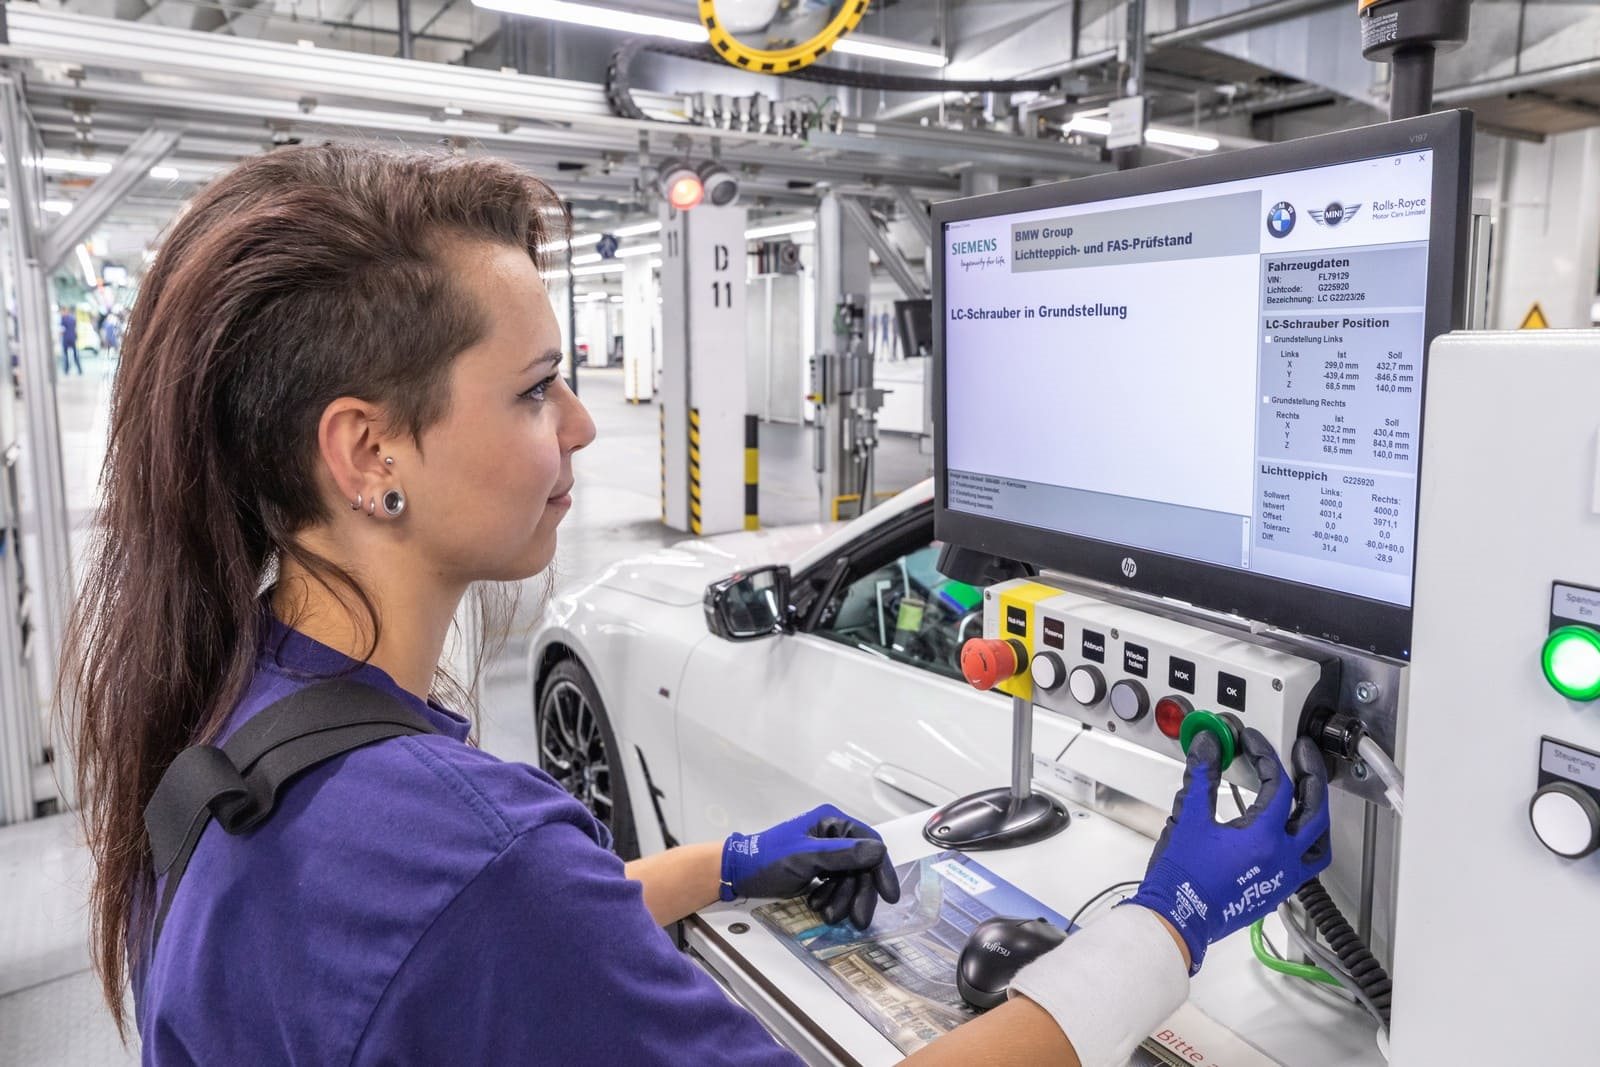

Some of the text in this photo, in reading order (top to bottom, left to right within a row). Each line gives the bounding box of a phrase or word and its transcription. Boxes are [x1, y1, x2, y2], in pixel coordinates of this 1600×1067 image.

[1372, 198, 1426, 210] Rolls-Royce
[1325, 210, 1342, 218] MINI
[1015, 226, 1073, 242] BMW Group
[952, 238, 997, 256] SIEMENS
[1015, 232, 1193, 261] Lichtteppich- und FAS-Prüfstand
[714, 244, 729, 272] D
[1268, 258, 1350, 272] Fahrzeugdaten
[1318, 272, 1349, 281] FL79129
[1267, 283, 1349, 294] Lichtcode: G225920
[712, 282, 732, 308] 11
[1267, 296, 1314, 304] Bezeichnung:
[1330, 293, 1365, 301] G22/23/26
[951, 303, 1127, 321] LC-Schrauber in Grundstellung
[1266, 318, 1389, 329] LC-Schrauber Position
[1273, 335, 1322, 344] Grundstellung
[1324, 362, 1344, 370] 299,0
[1376, 363, 1397, 371] 432,7
[1323, 372, 1344, 380] -439,4
[1325, 382, 1340, 391] 68,5
[1376, 384, 1396, 393] 140,0
[1271, 396, 1346, 408] Grundstellung Rechts
[1276, 411, 1300, 420] Rechts
[1322, 424, 1341, 434] 302,2
[1373, 429, 1394, 438] 430,4
[1322, 435, 1341, 444] 332,1
[1373, 440, 1393, 449] 843,8
[1324, 446, 1338, 454] 68,5
[1373, 450, 1393, 459] 140,0
[1261, 465, 1375, 487] Lichtteppich G225920
[1320, 487, 1400, 505] Links: Rechts:
[1264, 490, 1398, 517] Sollwert 4000,0 4000,0
[1263, 501, 1398, 529] Istwert 4031,4 3971,1
[1262, 512, 1391, 539] Offset 0,0 0,0
[1263, 522, 1290, 533] Toleranz
[1322, 544, 1336, 552] 31,4
[1375, 554, 1393, 563] -28,9
[1122, 557, 1136, 578] hp
[1084, 640, 1104, 652] Abbruch
[1174, 670, 1189, 680] NOK
[1226, 687, 1238, 696] OK
[1156, 1029, 1204, 1063] Bitte
